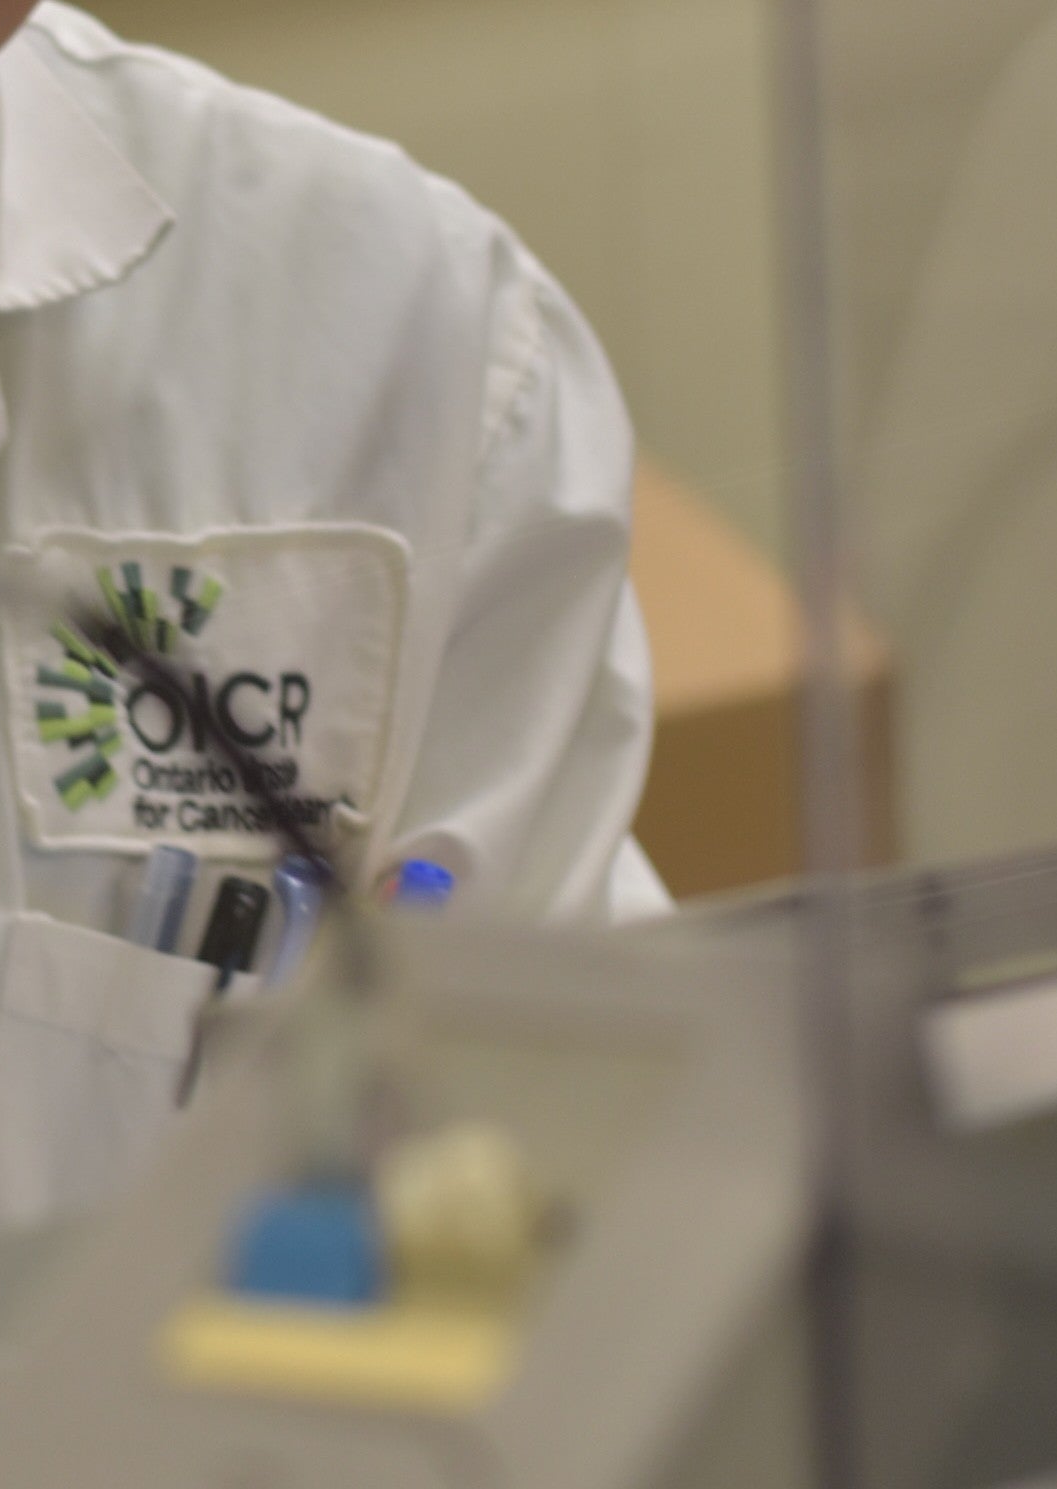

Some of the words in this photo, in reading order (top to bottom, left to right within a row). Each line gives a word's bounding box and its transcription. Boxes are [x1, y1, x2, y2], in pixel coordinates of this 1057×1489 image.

[127, 671, 310, 753] OICR
[133, 758, 236, 793] Ontario
[134, 795, 169, 829] for
